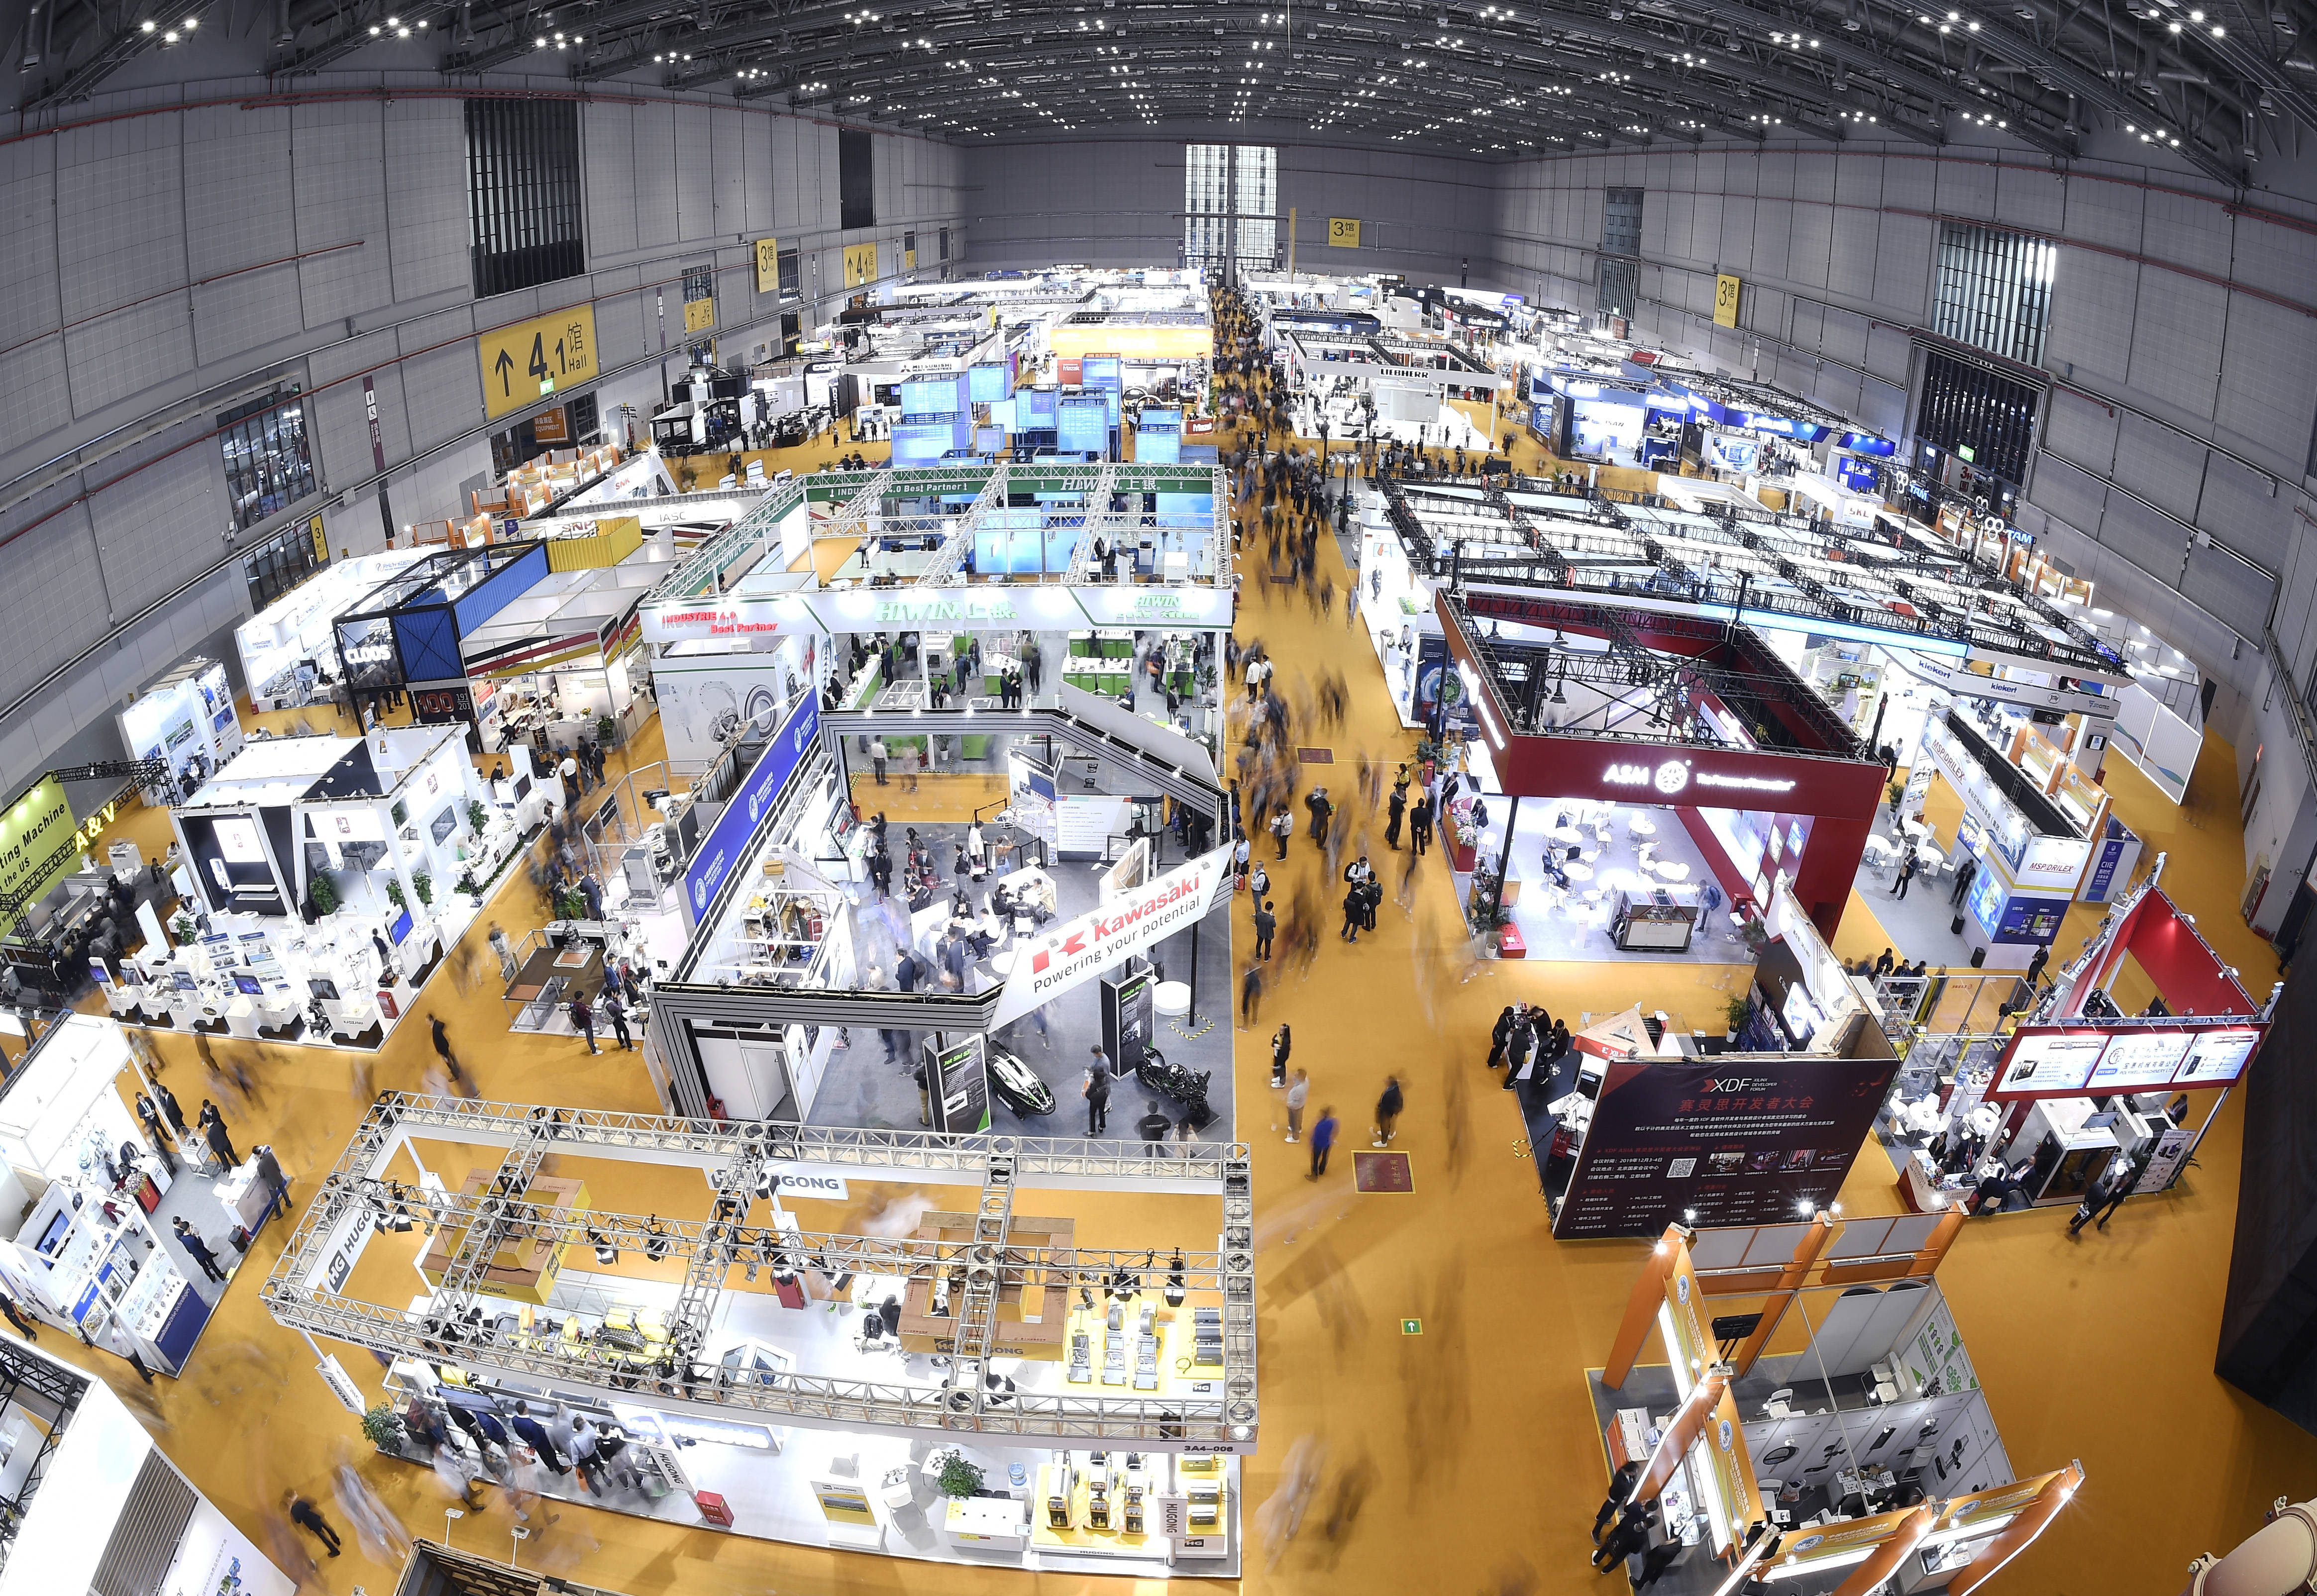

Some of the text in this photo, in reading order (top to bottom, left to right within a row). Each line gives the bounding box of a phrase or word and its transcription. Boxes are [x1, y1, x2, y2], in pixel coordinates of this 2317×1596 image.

[1334, 221, 1355, 236] 3 馆
[760, 245, 768, 273] 3
[1719, 280, 1727, 306] 3
[528, 322, 583, 383] 4.1 馆
[569, 355, 587, 372] Hall
[1380, 369, 1429, 379] LIEBHERR
[888, 485, 901, 494] 4.0
[927, 483, 961, 492] Partner
[1060, 479, 1119, 491] HIWN
[1909, 485, 1928, 501] TAM
[660, 512, 686, 522] IASC
[1850, 508, 1869, 518] SKL
[315, 527, 321, 539] 3
[2006, 529, 2033, 545] TAM
[1134, 595, 1182, 607] HIWIN
[662, 611, 736, 623] INDUSTRIE 4.0
[875, 600, 961, 621] HIWIN
[710, 622, 778, 633] Best Partner
[345, 644, 391, 664] CLOOS
[1919, 660, 1951, 679] kiekert
[1991, 683, 2017, 693] kiekert
[419, 692, 454, 714] 100
[456, 693, 469, 701] 191
[459, 702, 470, 710] 201
[1603, 764, 1649, 785] ASM
[22, 803, 65, 848] Machine
[4, 857, 30, 888] the US
[1094, 872, 1200, 942] Kawasaki
[1034, 897, 1201, 993] Powering your potential
[1121, 989, 1134, 999] Ninja
[953, 1053, 962, 1062] Ski
[1710, 1078, 1753, 1093] XDF
[1679, 1096, 1814, 1113] 赛灵思开发者大会
[329, 1255, 346, 1286] HG
[156, 1320, 173, 1343] Sumitomo
[282, 1318, 459, 1367] TOTAL WELDING AND CUTTING SOLUTIONS
[325, 1375, 354, 1408] HUGONG
[657, 1452, 684, 1485] HUGONG
[1166, 1503, 1177, 1533] HUGONG
